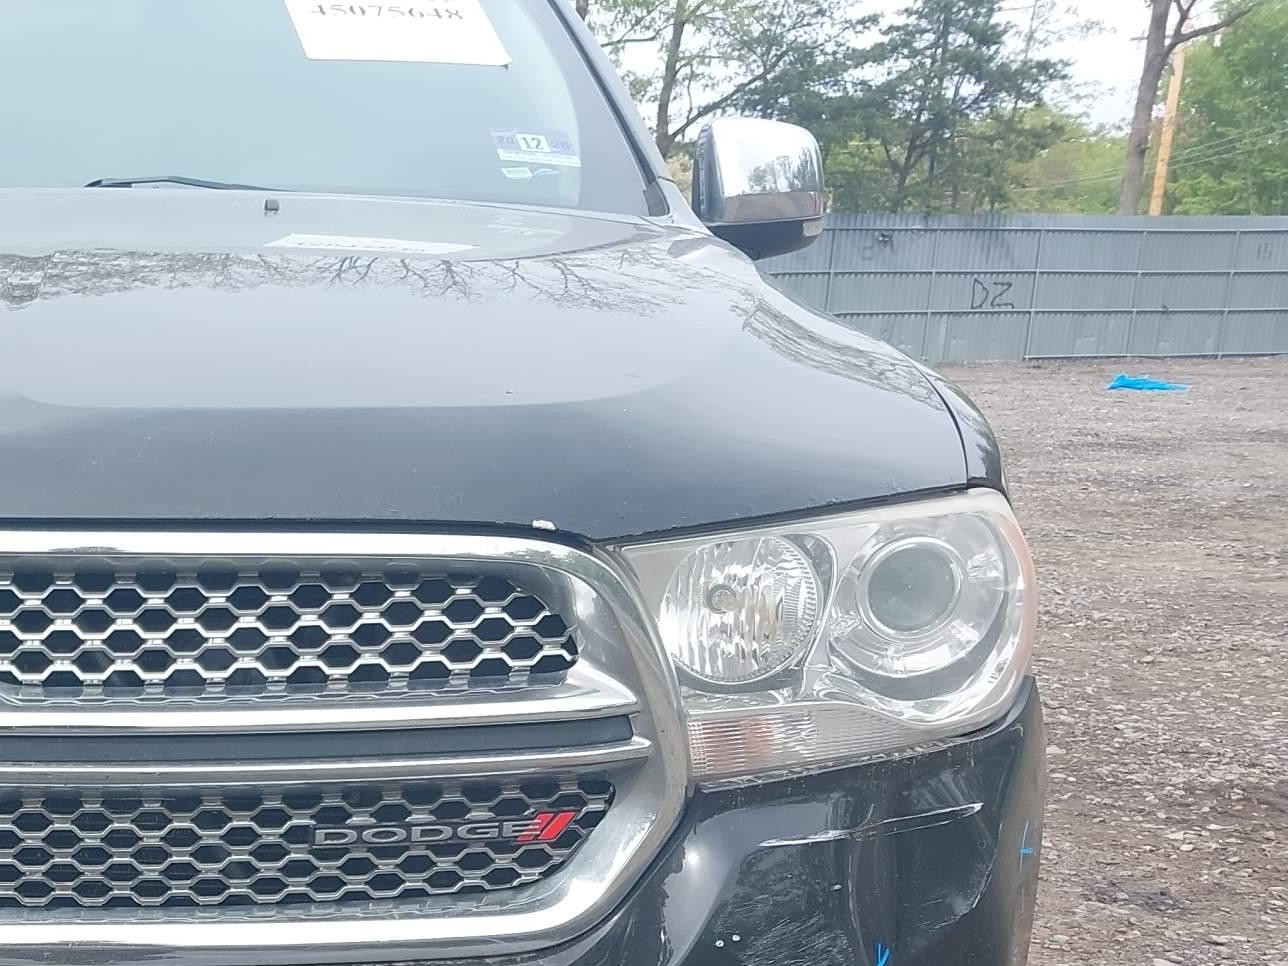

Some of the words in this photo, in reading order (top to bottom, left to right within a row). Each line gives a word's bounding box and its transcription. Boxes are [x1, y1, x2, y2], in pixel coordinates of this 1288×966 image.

[310, 2, 465, 21] 45075648
[520, 136, 545, 150] 12
[313, 820, 541, 846] DODGE
